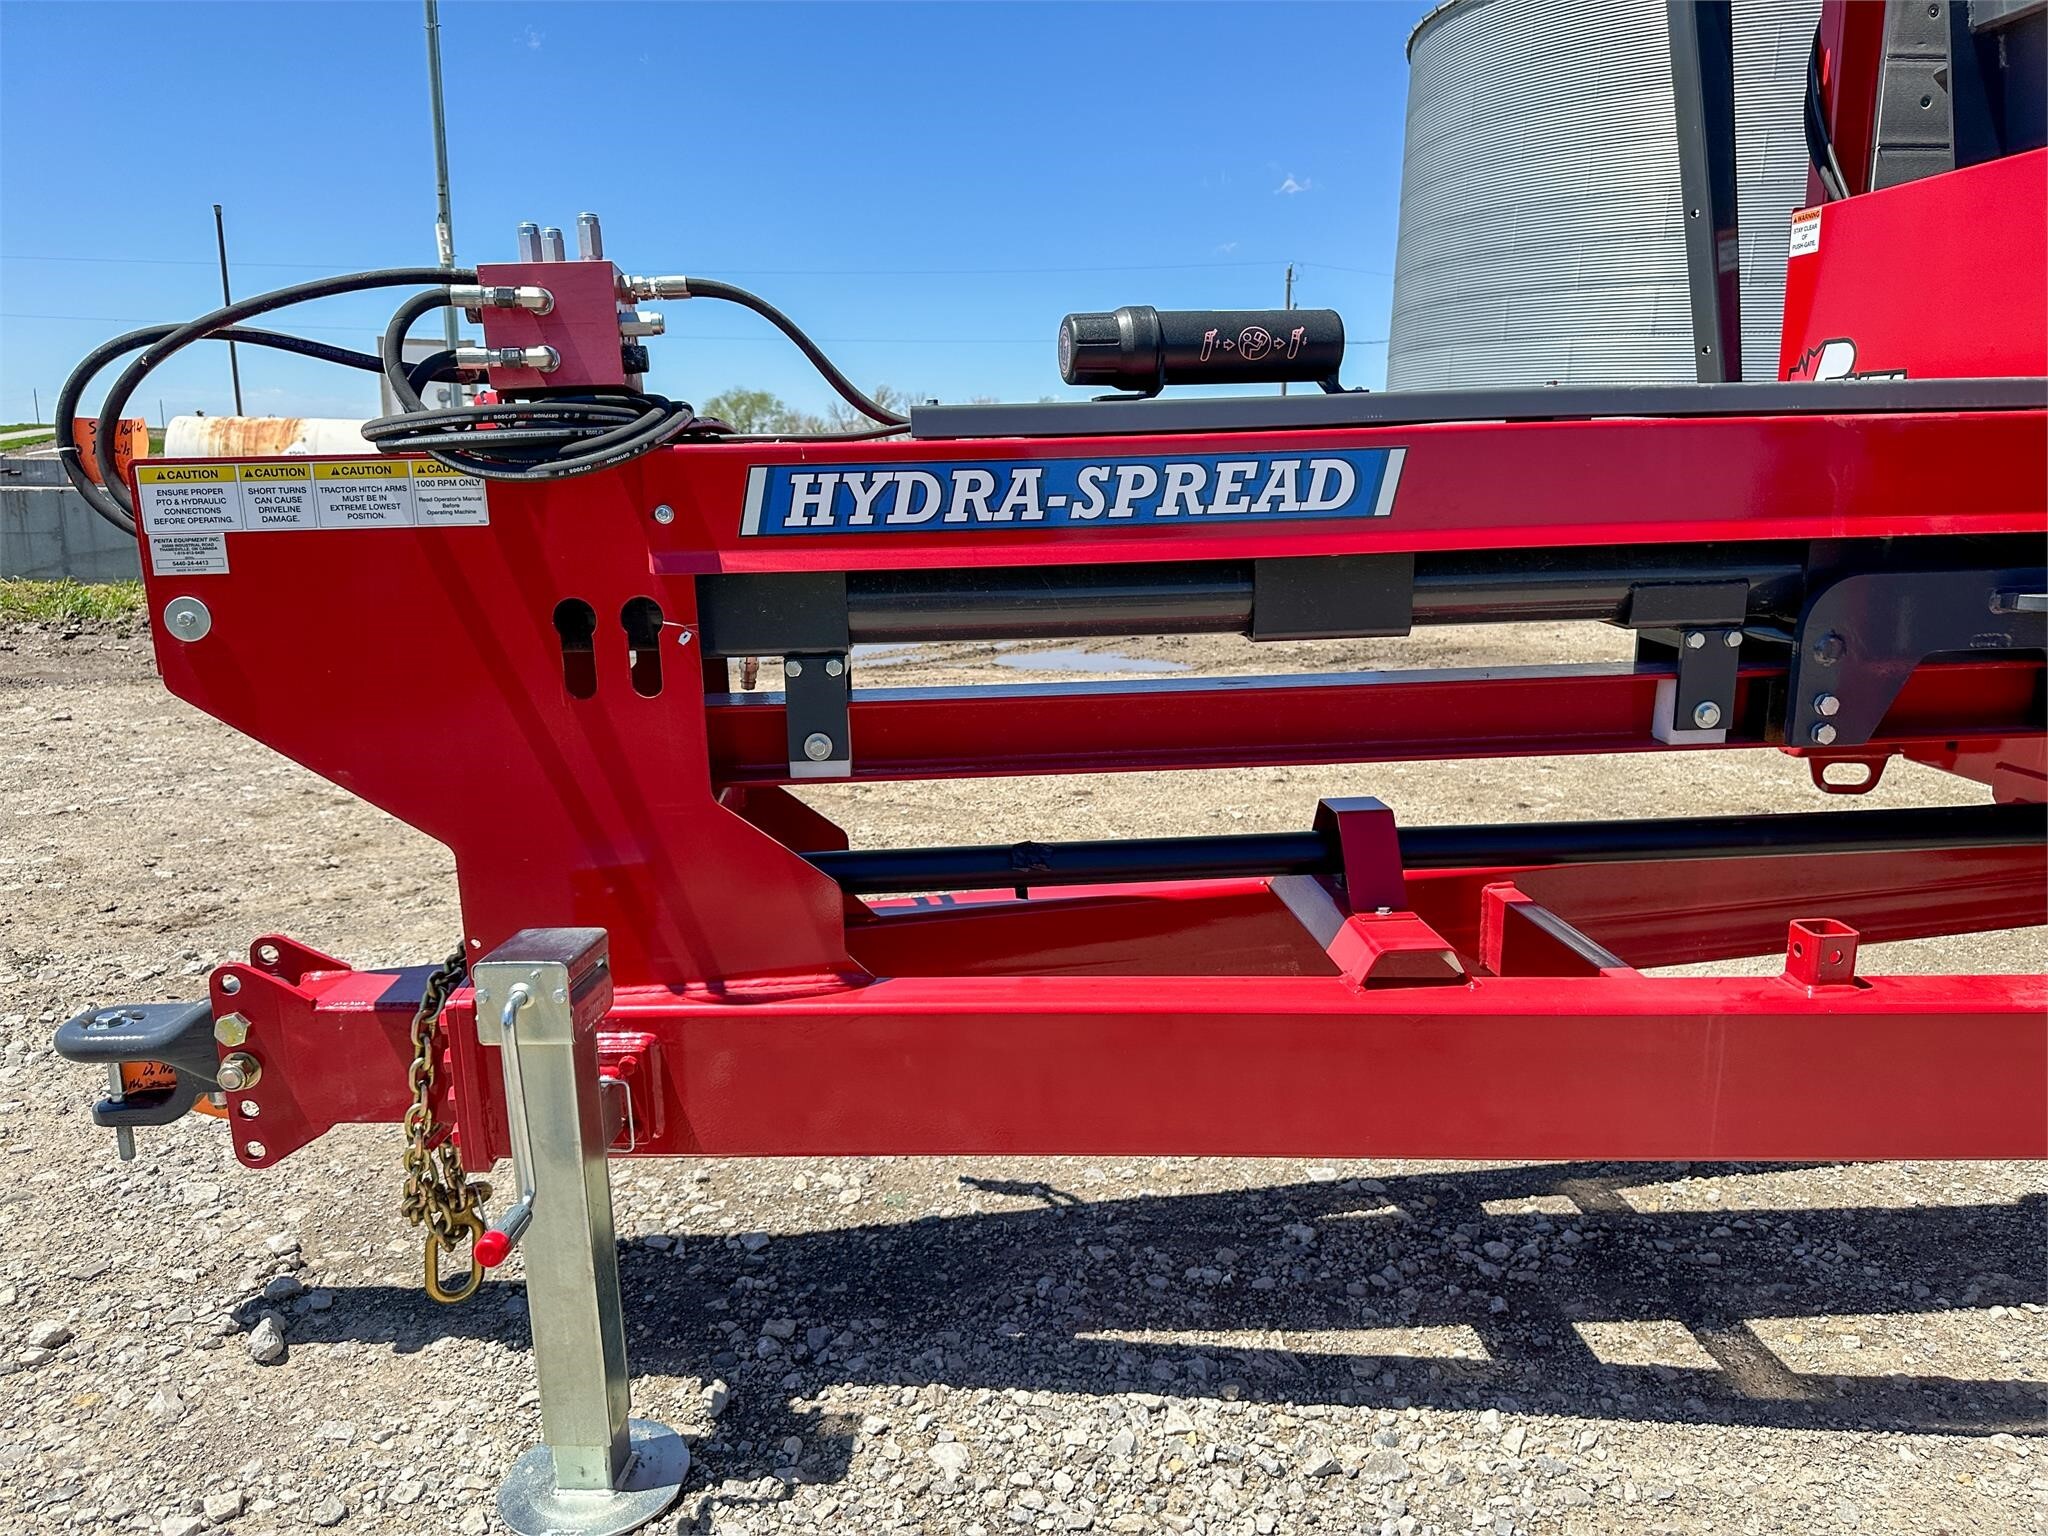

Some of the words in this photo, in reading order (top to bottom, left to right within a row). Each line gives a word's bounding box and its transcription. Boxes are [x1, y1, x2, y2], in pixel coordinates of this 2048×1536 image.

[1798, 210, 1820, 221] WARNING
[1804, 223, 1818, 232] CLEAR
[166, 470, 219, 480] CAUTION
[254, 468, 306, 478] CAUTION
[341, 466, 392, 476] CAUTION
[458, 478, 480, 486] ONLY
[784, 458, 1356, 527] HYDRA-SPREAD
[164, 507, 222, 515] CONNECTIONS
[258, 506, 302, 514] DRIVELINE
[330, 504, 367, 512] EXTREME
[368, 502, 401, 510] LOWEST
[154, 517, 186, 525] BEFORE
[188, 516, 234, 524] OPERATING.
